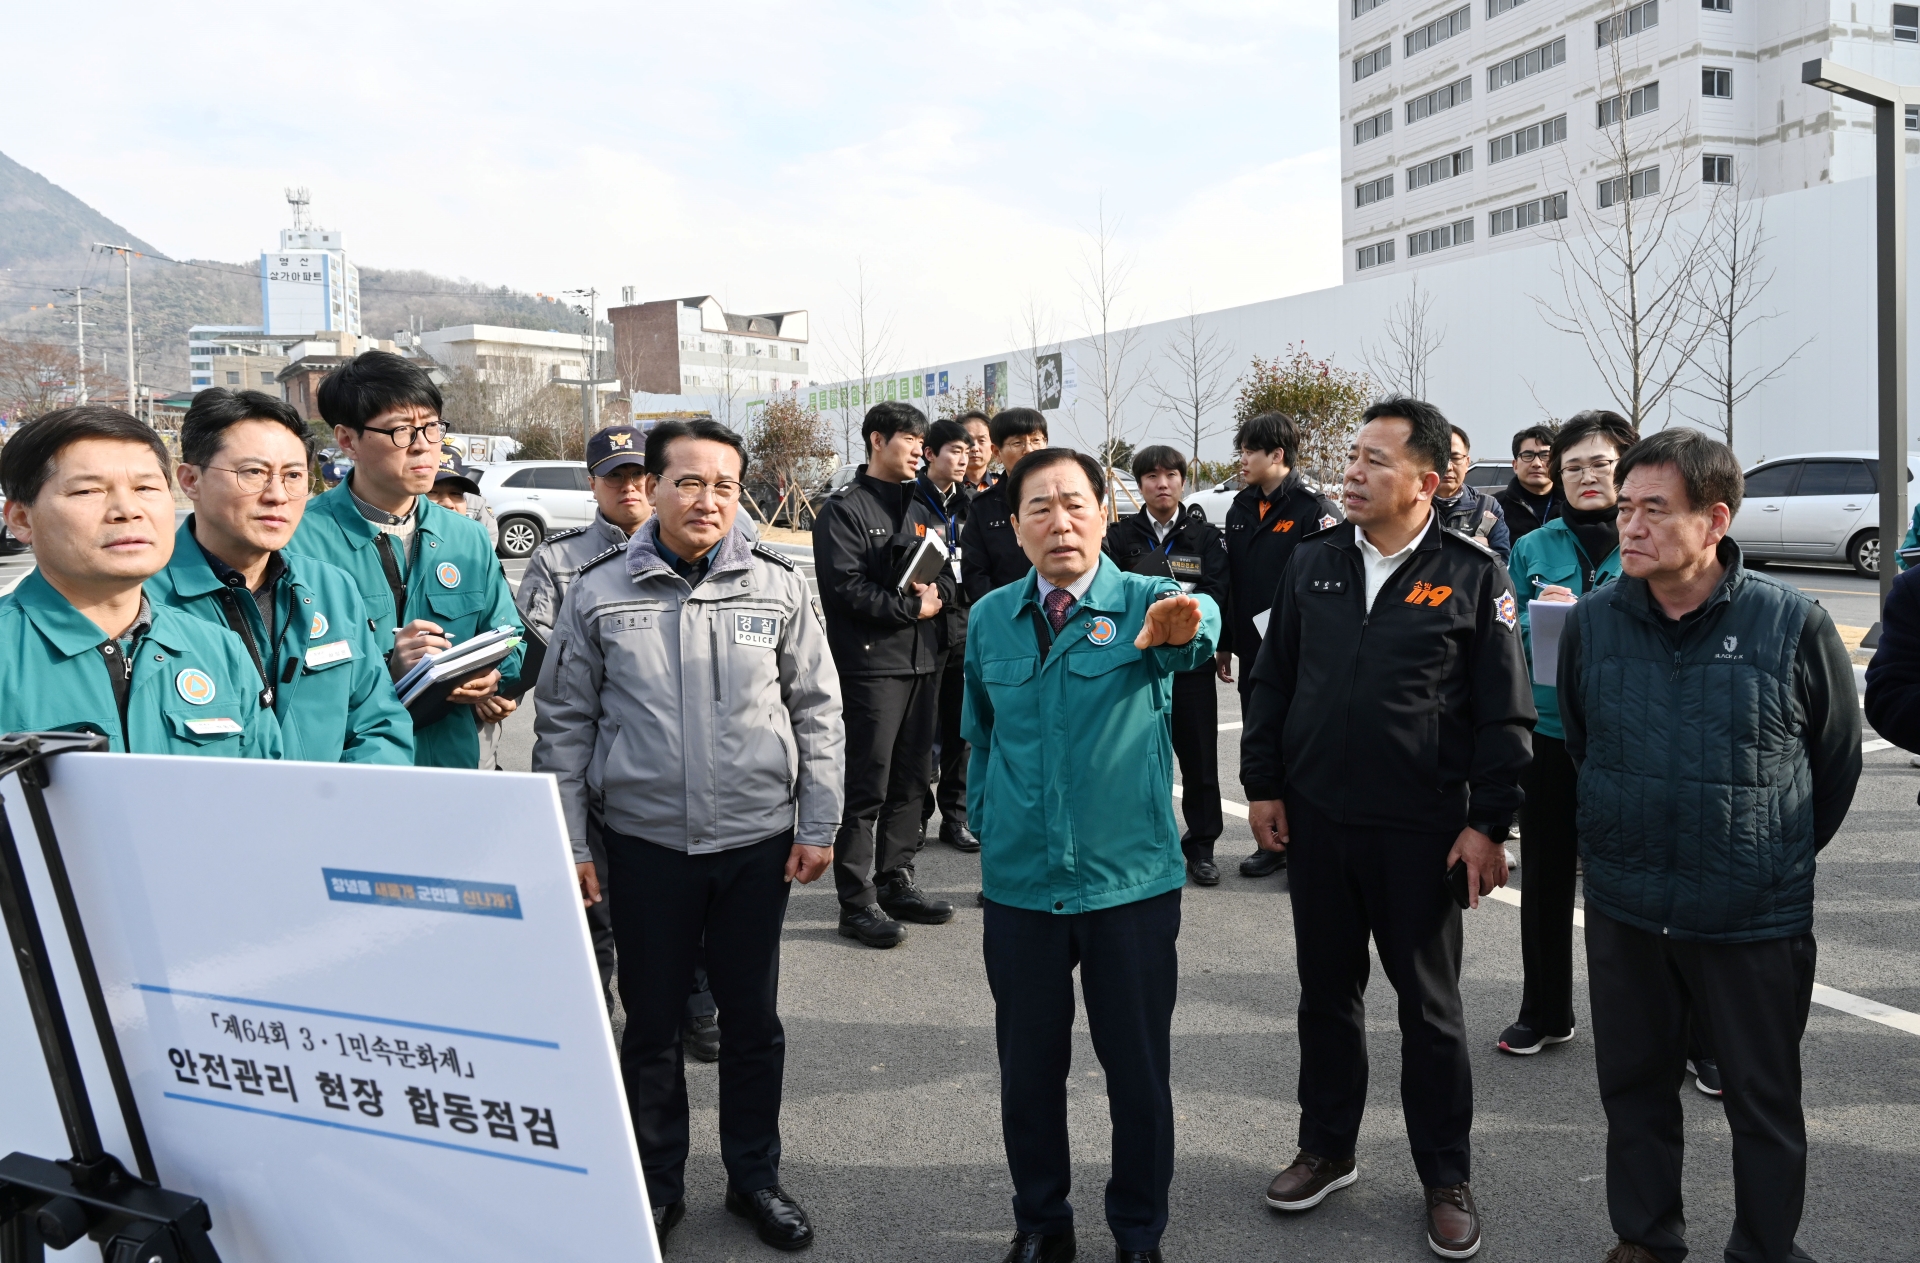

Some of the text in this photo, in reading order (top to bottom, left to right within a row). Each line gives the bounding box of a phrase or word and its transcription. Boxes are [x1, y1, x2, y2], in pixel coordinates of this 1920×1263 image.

[269, 271, 323, 281] 상가아파트
[1271, 519, 1295, 533] 119
[1414, 580, 1433, 591] 소방
[1404, 585, 1453, 607] 119
[739, 634, 773, 644] POLICE
[330, 877, 514, 910] 창녕을 새롭게 군민을 신나게!
[168, 1047, 560, 1150] 안전관리 현장 합동점검
